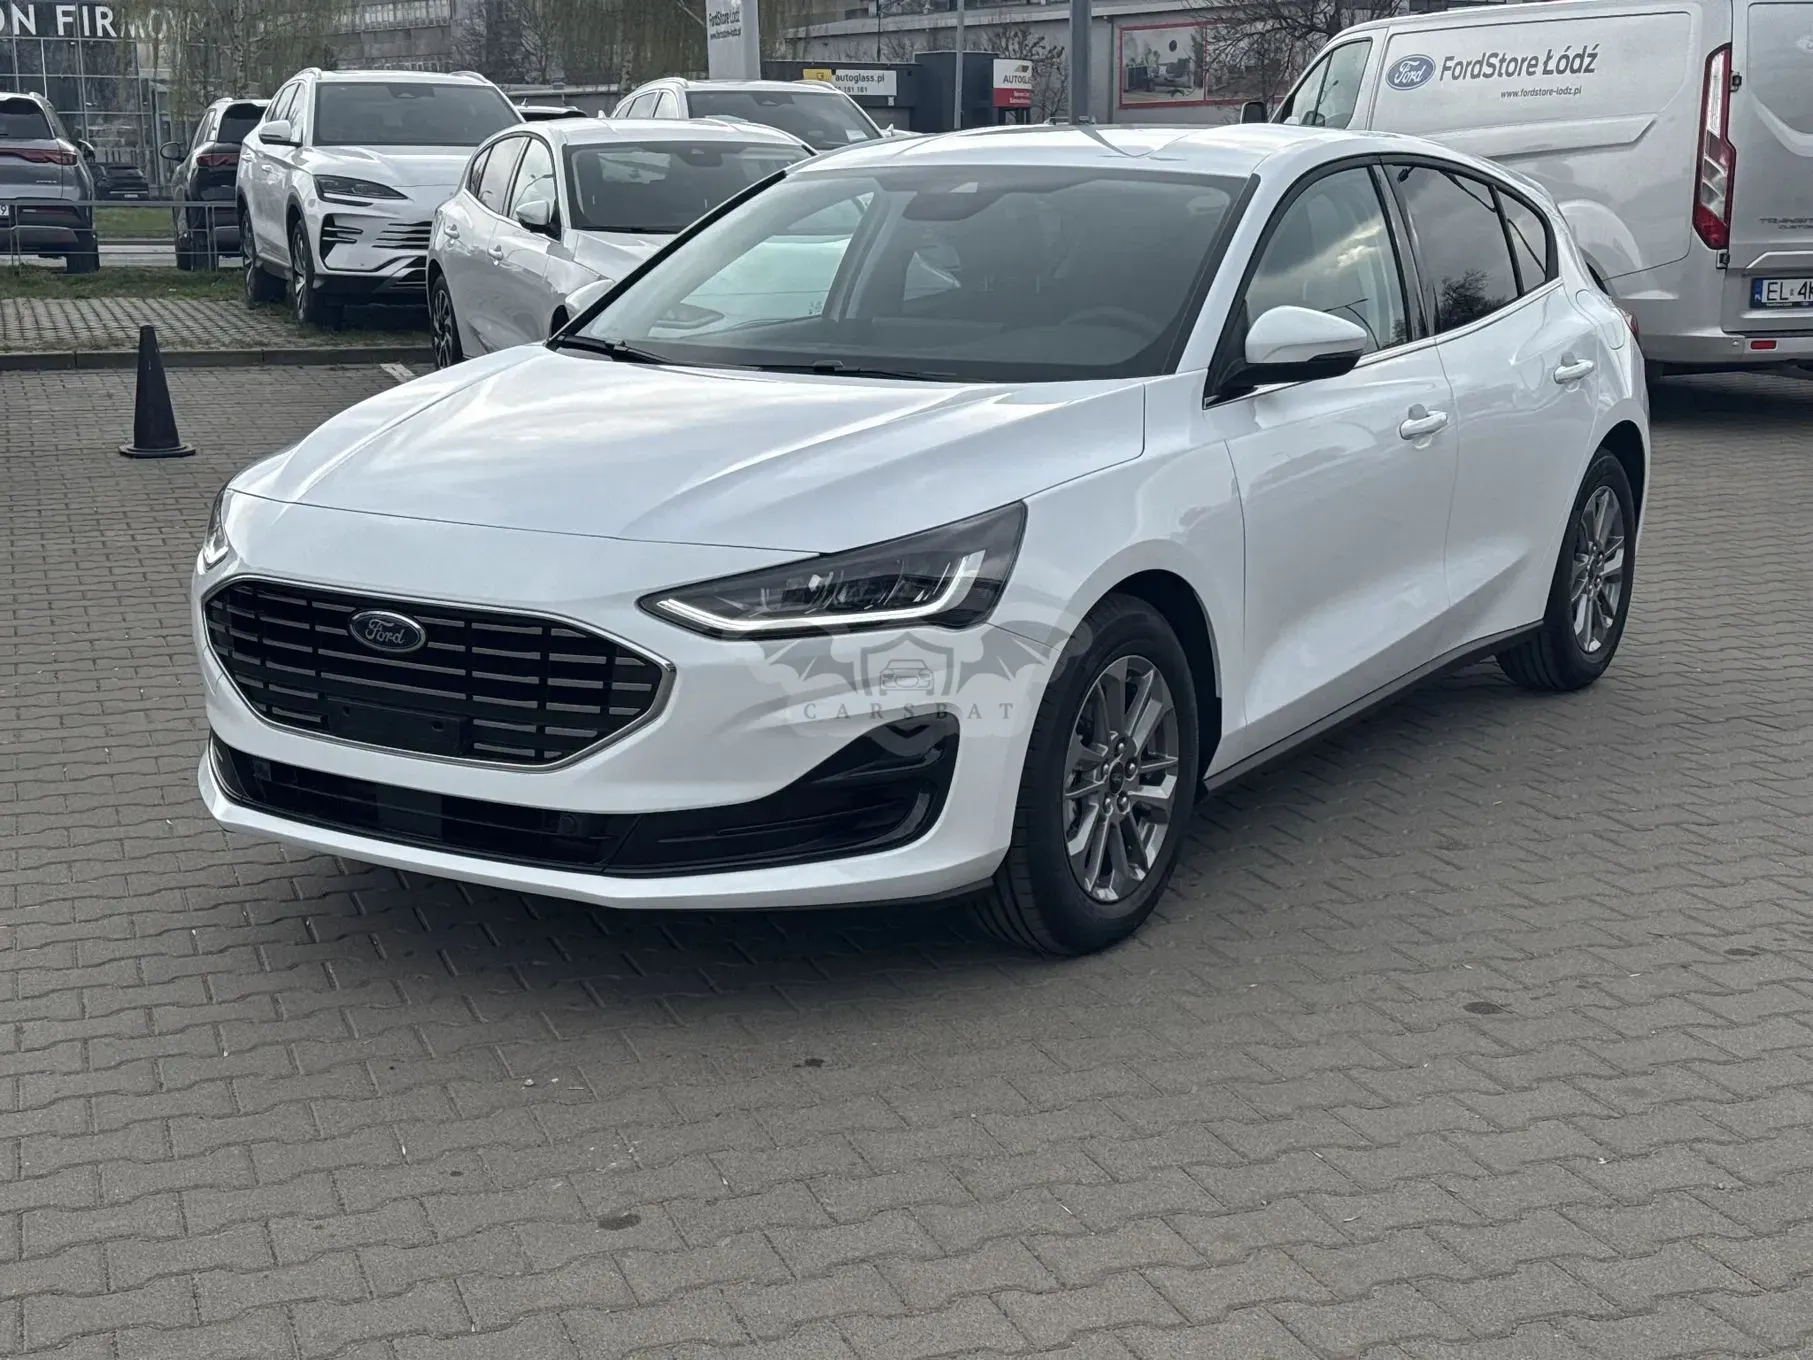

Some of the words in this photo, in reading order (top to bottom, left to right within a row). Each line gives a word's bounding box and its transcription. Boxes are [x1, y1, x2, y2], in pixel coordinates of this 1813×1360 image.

[0, 3, 37, 36] N
[1439, 52, 1539, 82] FordStore
[1542, 43, 1600, 76] Łódź
[1501, 85, 1583, 98] www.fordstore-lodz.pl
